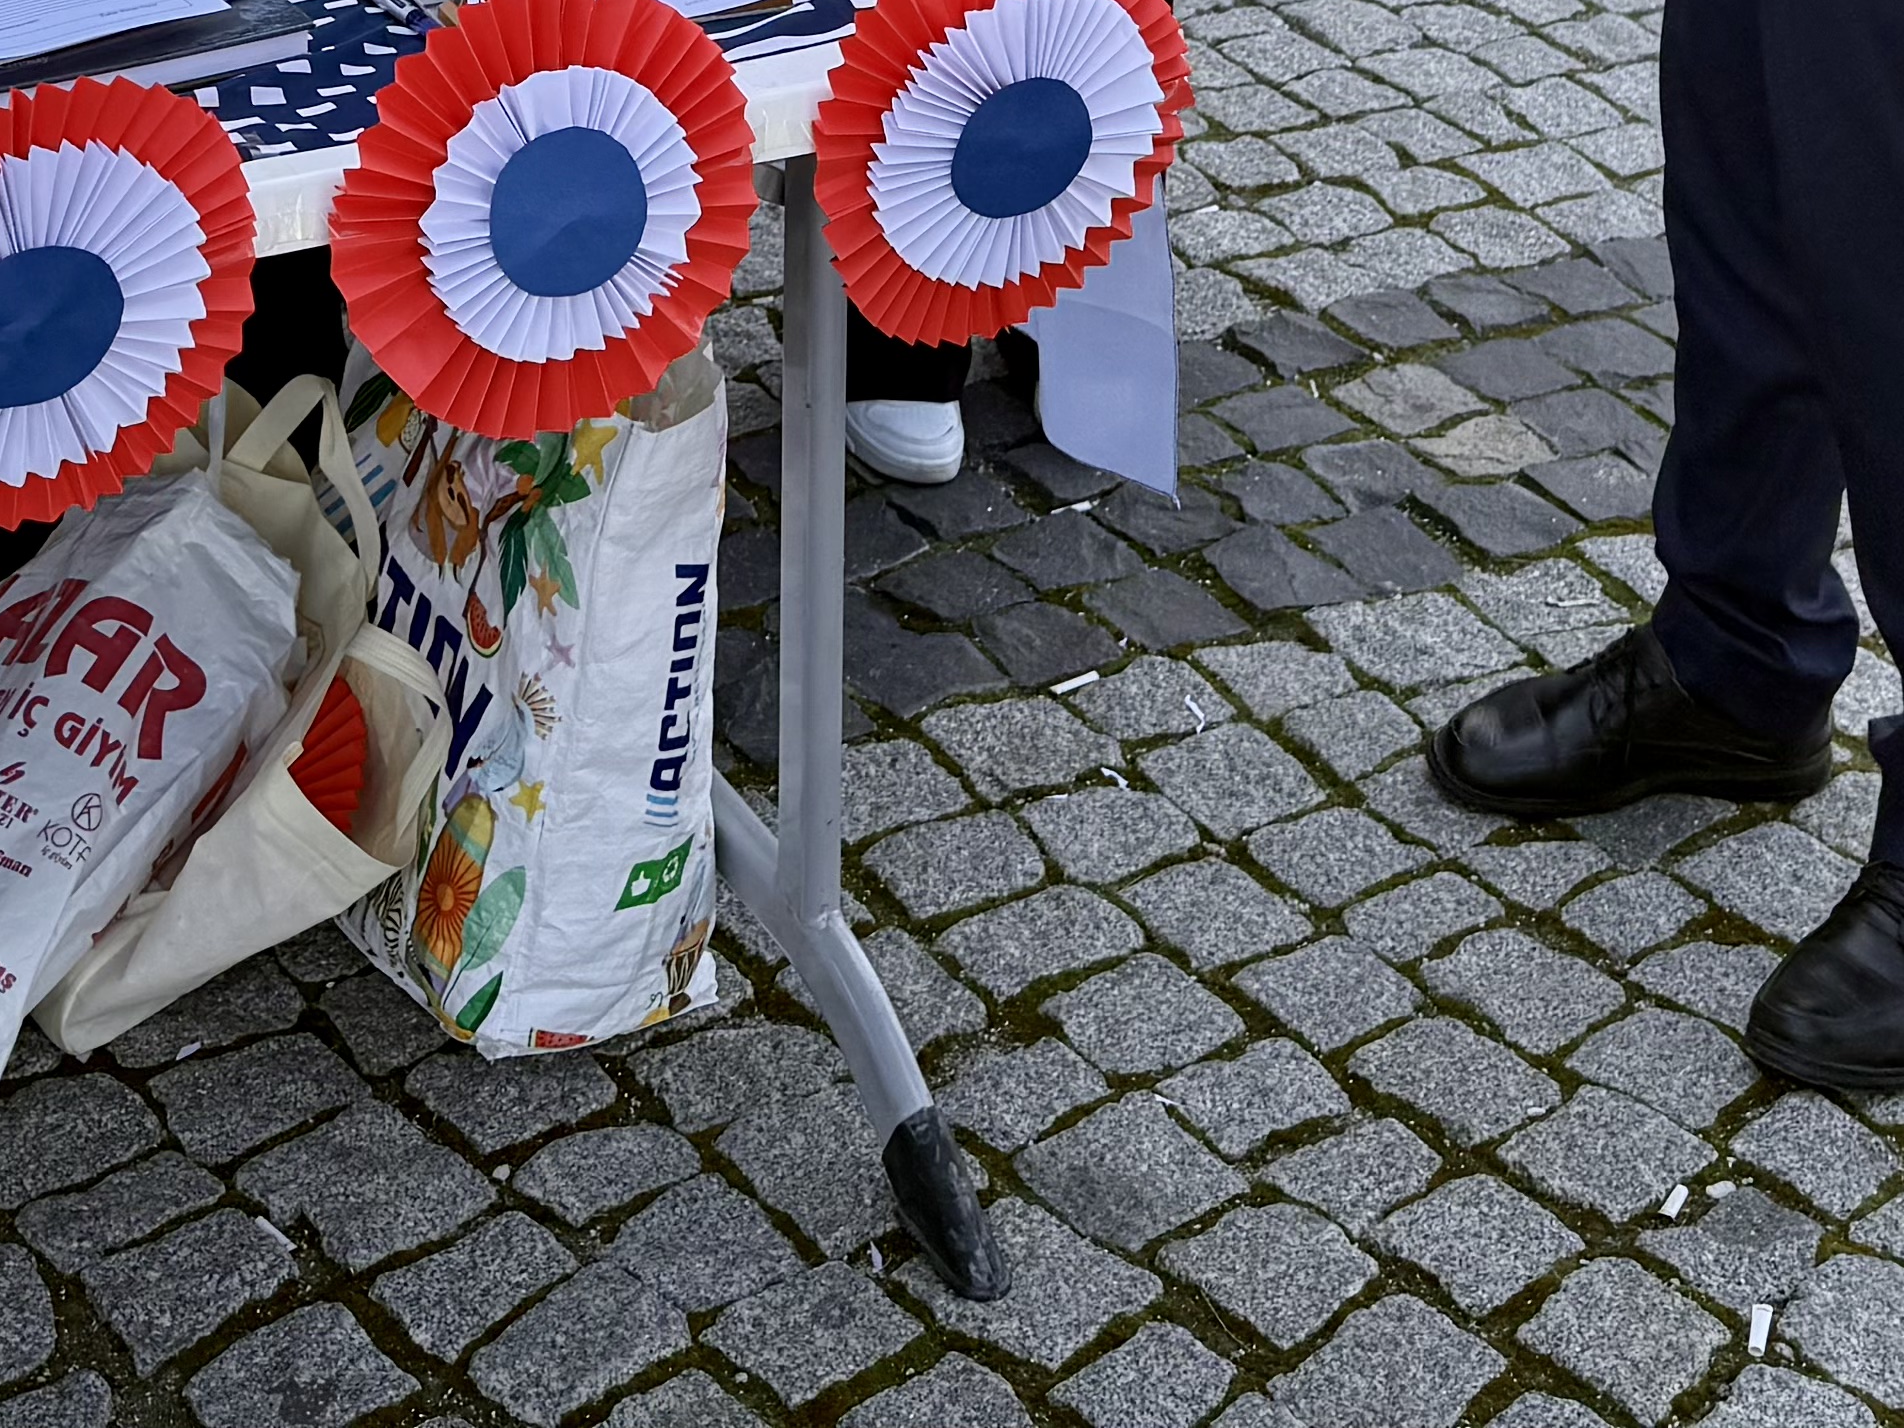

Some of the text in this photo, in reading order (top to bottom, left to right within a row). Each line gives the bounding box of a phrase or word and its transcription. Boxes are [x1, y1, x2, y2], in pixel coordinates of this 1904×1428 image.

[8, 682, 50, 738] İÇ
[54, 711, 140, 807] GİYİM
[372, 536, 494, 781] TION
[649, 564, 709, 792] ACTION
